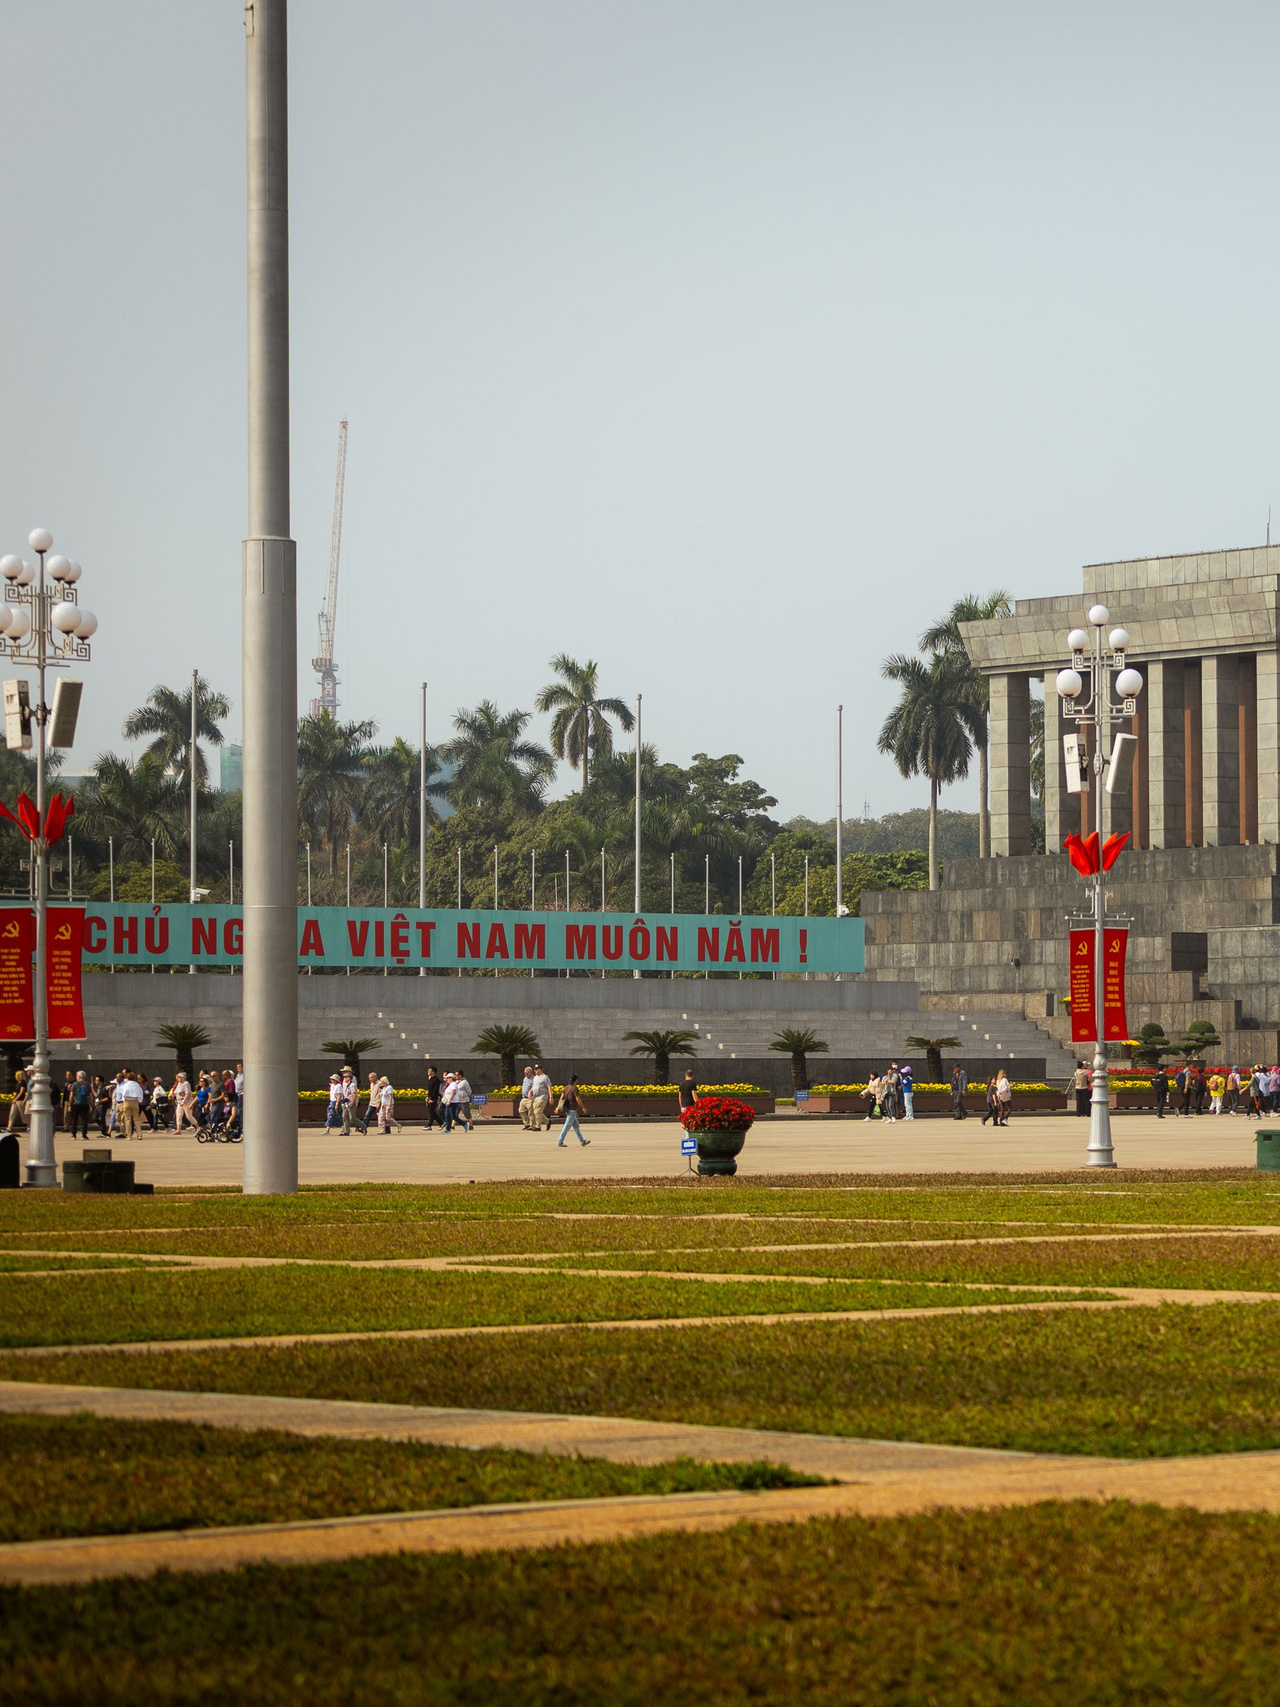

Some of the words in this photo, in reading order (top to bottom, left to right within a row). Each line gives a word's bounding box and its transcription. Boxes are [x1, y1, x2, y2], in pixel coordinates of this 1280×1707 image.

[83, 906, 169, 955] CHỦ
[191, 917, 326, 956] NGA
[346, 913, 437, 964] VIỆT
[457, 922, 546, 960] NAM
[565, 918, 679, 962] MUÔN
[698, 920, 780, 963] NĂM
[799, 929, 808, 963] !
